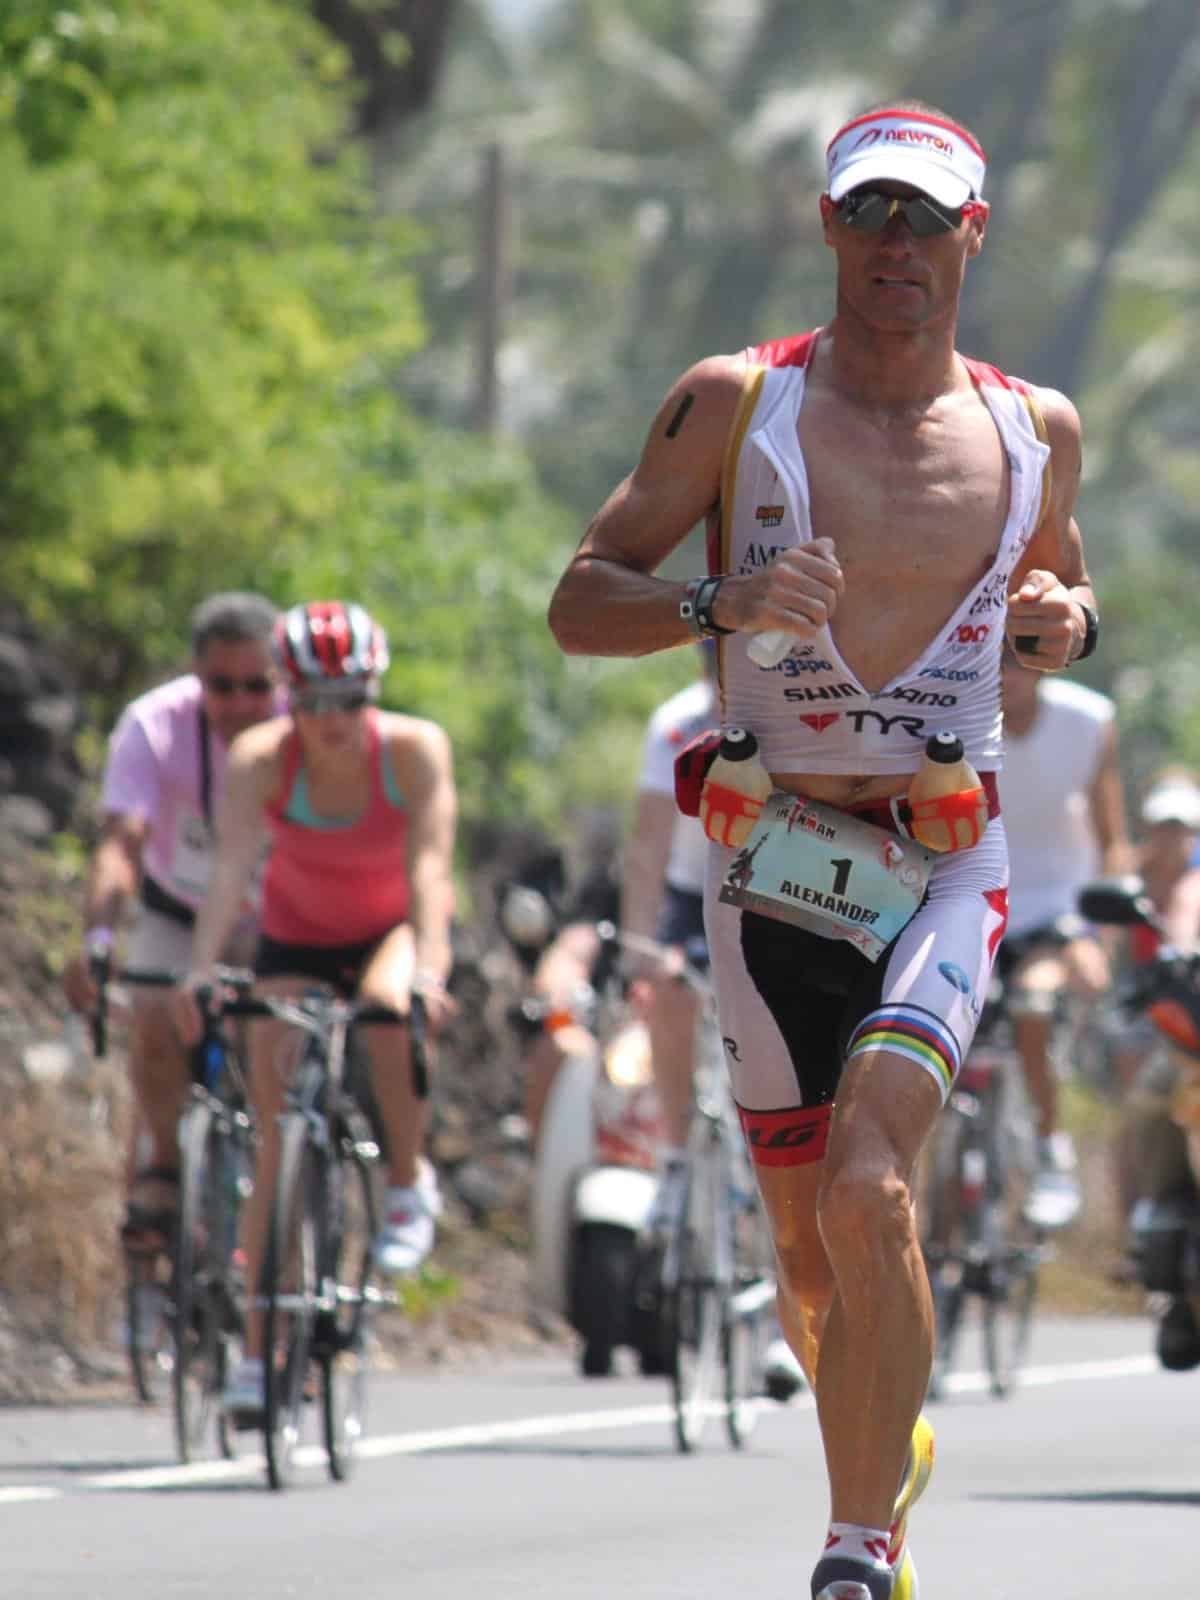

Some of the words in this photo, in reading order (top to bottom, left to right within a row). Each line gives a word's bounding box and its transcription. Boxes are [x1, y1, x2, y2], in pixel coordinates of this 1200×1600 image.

[845, 710, 928, 739] TYR
[830, 858, 854, 897] 1
[779, 879, 881, 926] ALEXANDER
